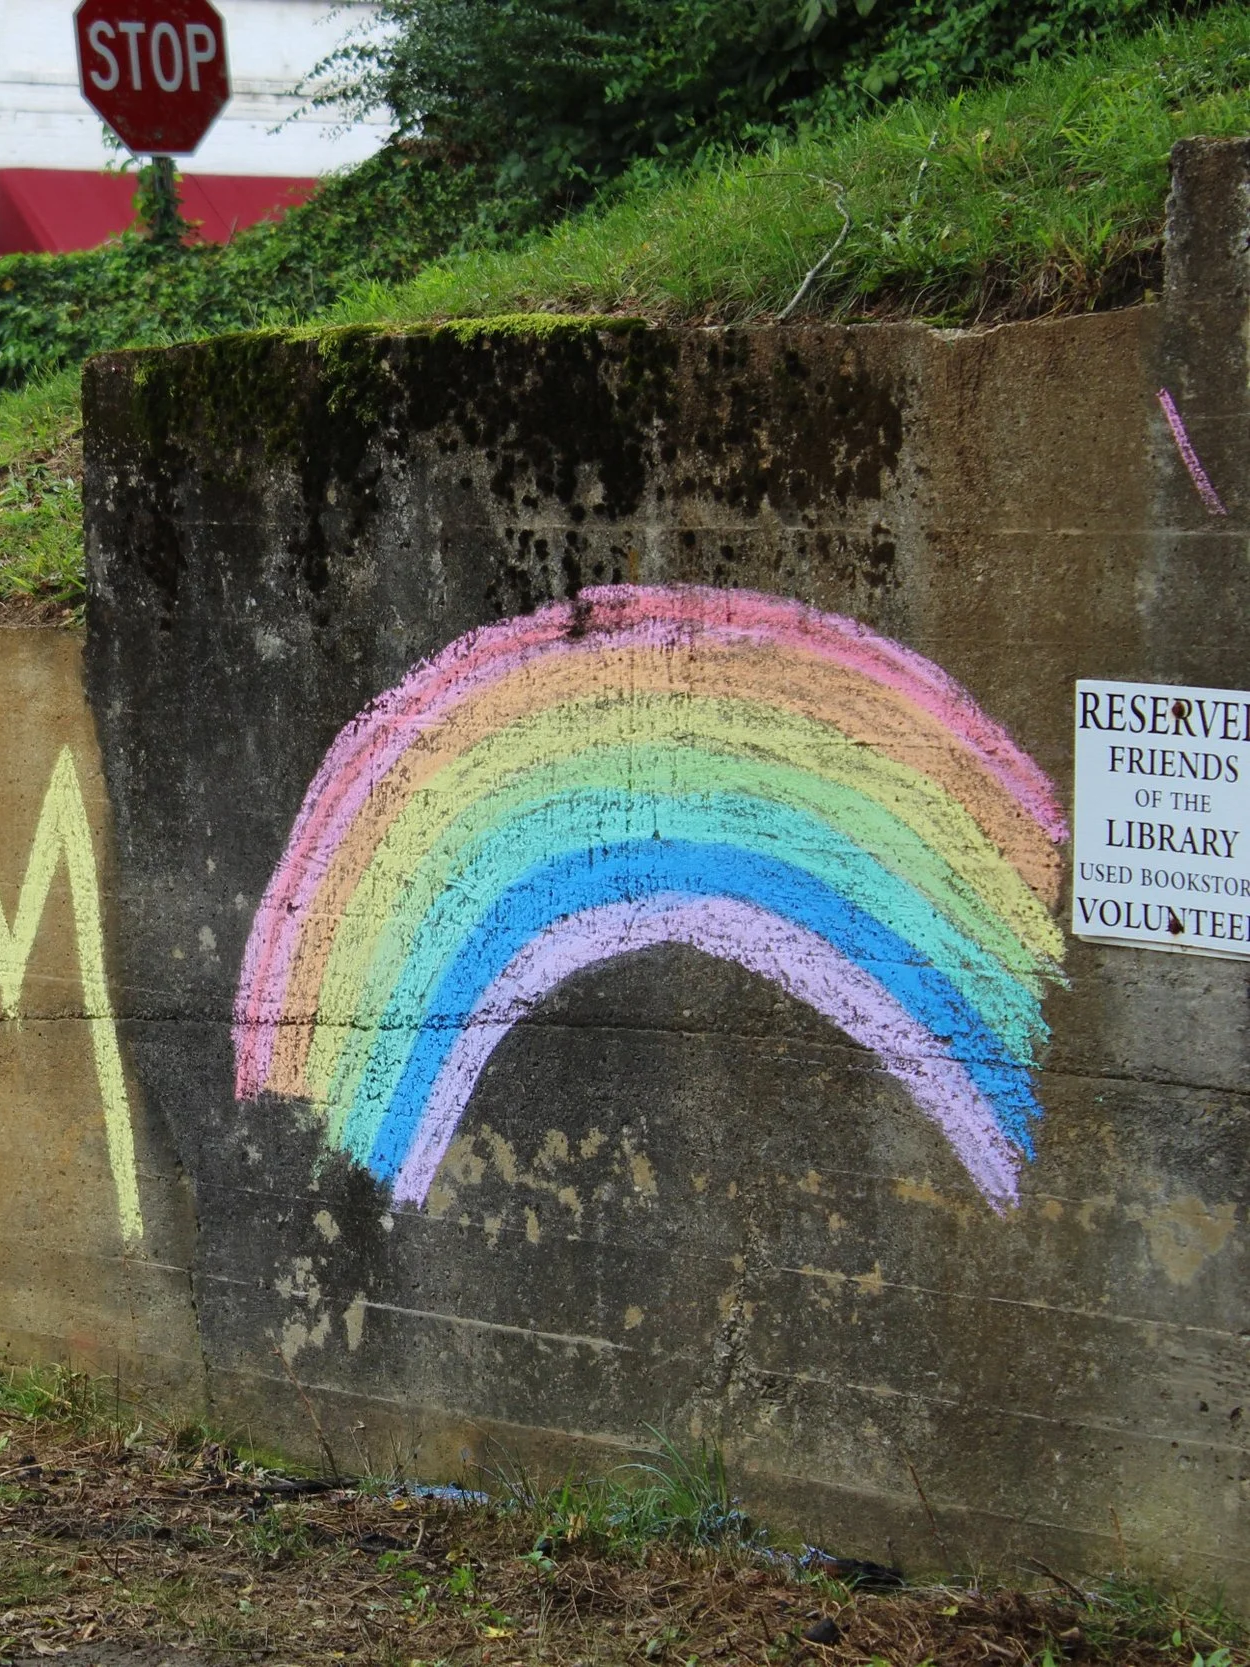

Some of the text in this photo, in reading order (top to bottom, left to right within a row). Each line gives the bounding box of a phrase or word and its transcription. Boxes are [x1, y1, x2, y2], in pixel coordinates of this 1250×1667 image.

[89, 20, 217, 92] STOP
[1108, 746, 1239, 783] FRIENDS
[1135, 789, 1212, 813] OF THE
[1106, 819, 1240, 858] LIBRARY
[1080, 863, 1132, 885] USED
[1077, 897, 1250, 942] VOLUNTEE
